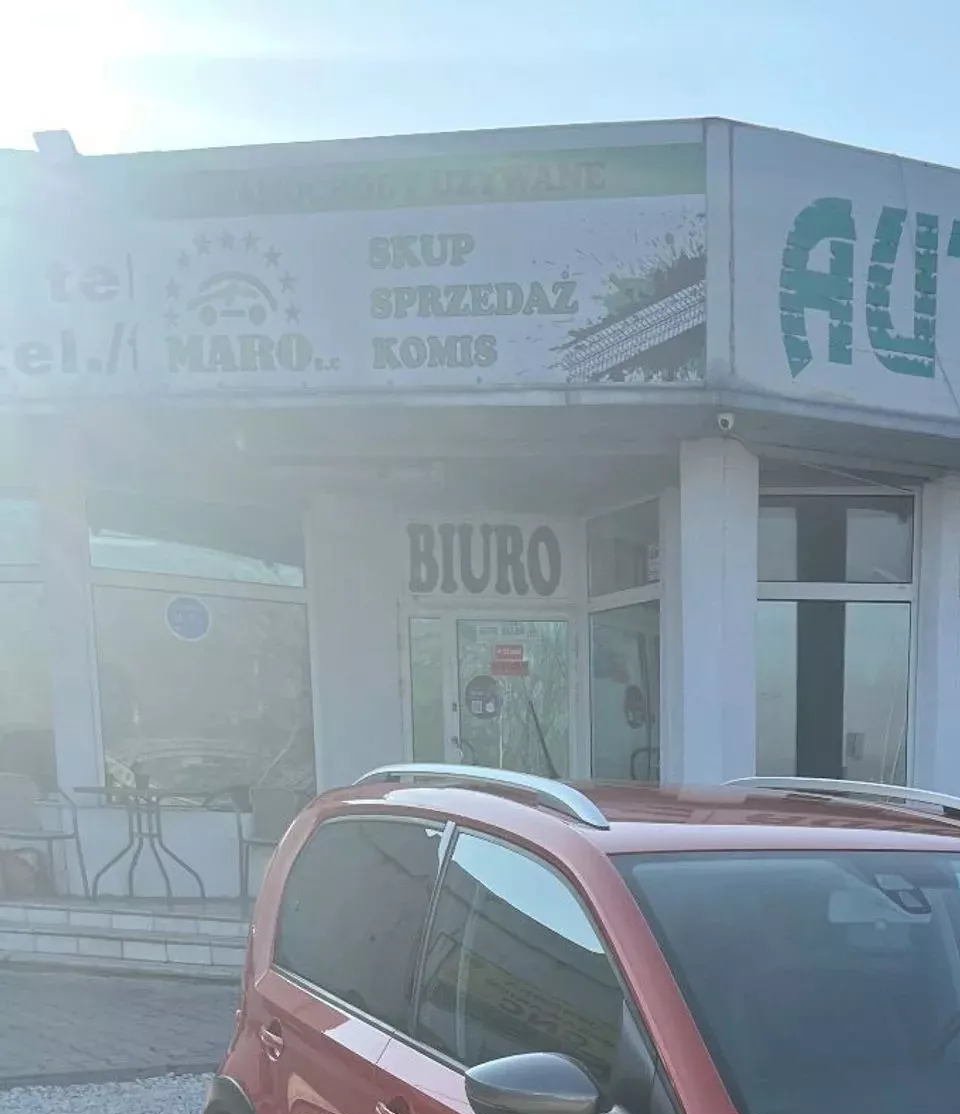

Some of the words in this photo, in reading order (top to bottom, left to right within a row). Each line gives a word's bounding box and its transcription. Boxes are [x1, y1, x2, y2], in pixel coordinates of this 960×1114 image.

[368, 232, 476, 270] SKUP
[369, 270, 579, 319] SPRZEDAŻ
[164, 333, 313, 373] MARO
[371, 334, 499, 371] KOMIS
[407, 522, 562, 597] BIURO
